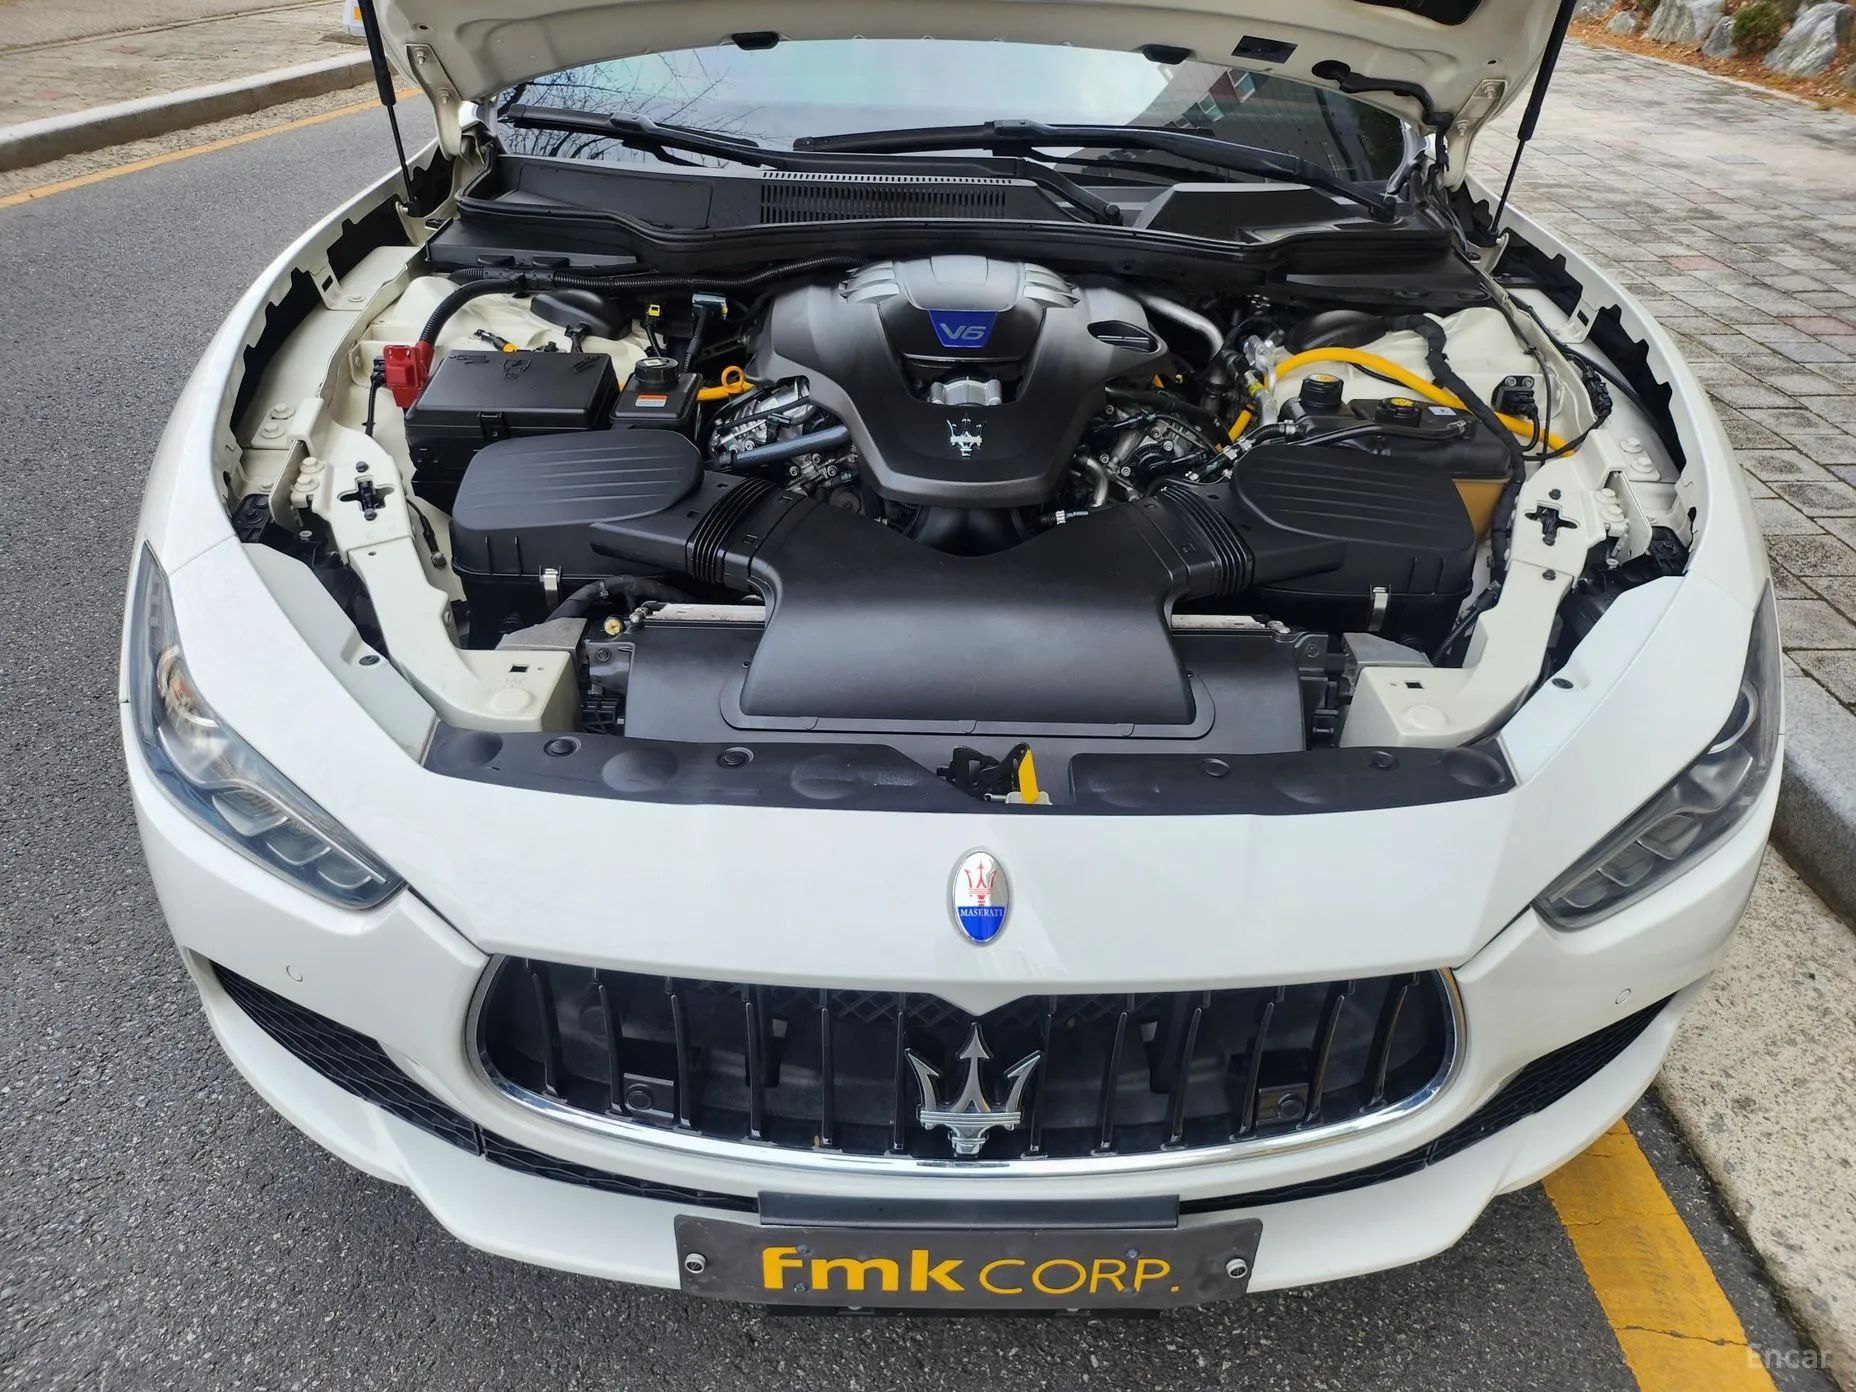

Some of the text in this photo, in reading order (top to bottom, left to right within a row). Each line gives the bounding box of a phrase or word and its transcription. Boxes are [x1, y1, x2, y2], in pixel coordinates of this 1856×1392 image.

[939, 322, 987, 341] V6
[960, 908, 1003, 917] MASERATI
[762, 1246, 1180, 1295] fmk CORP.
